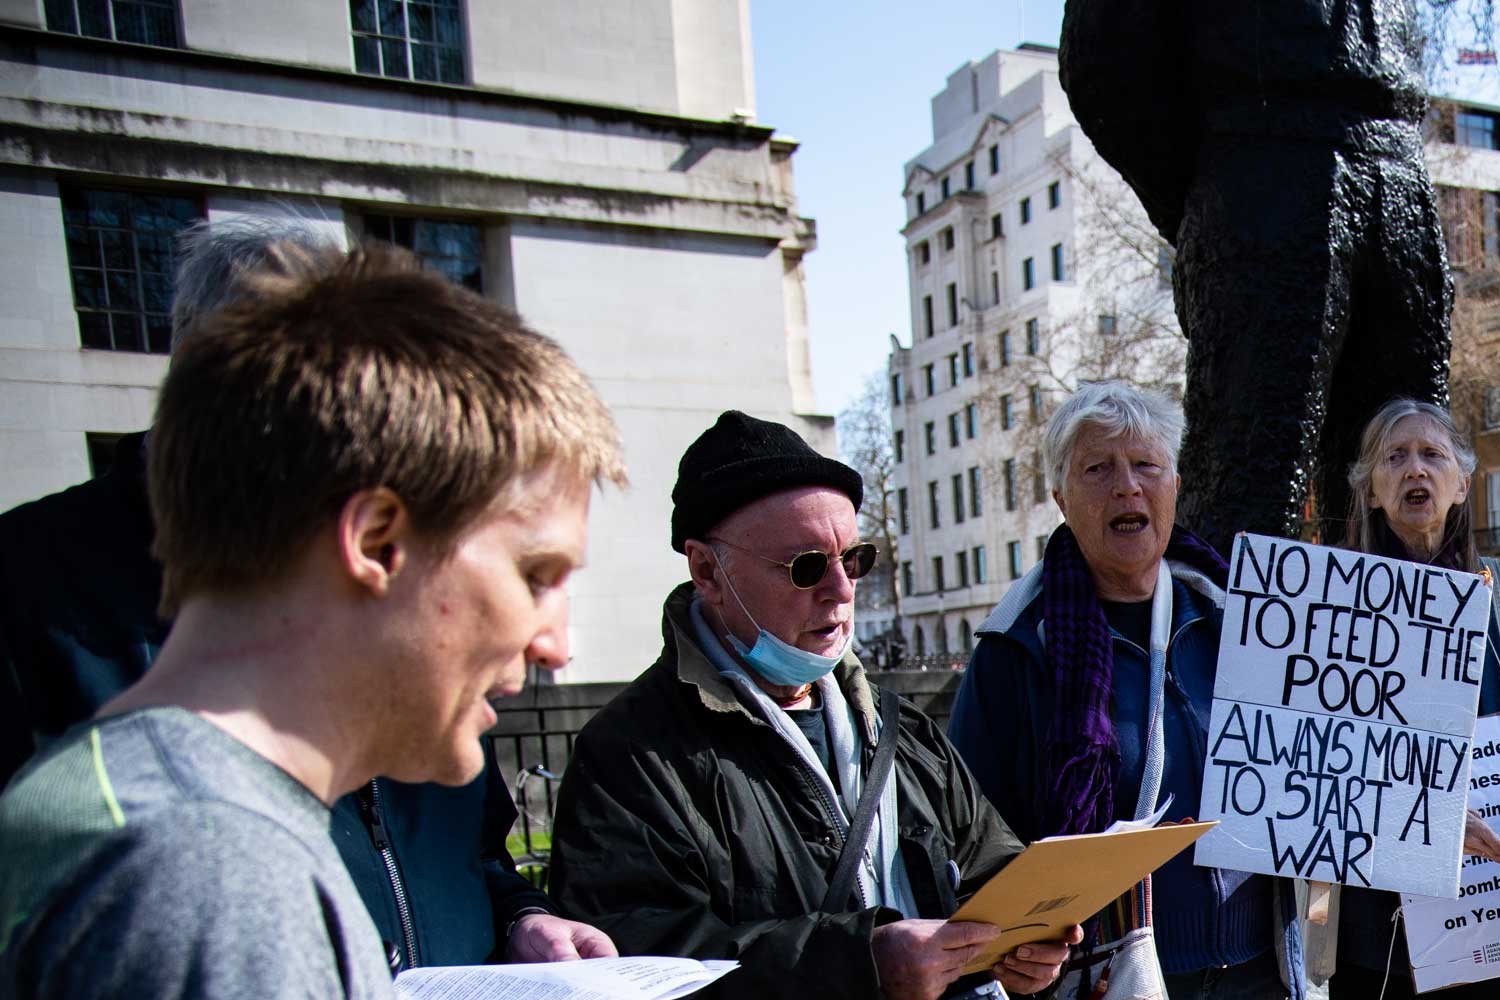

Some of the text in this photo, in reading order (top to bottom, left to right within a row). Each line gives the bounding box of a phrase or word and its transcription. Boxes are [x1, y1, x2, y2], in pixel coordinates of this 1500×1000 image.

[1233, 535, 1479, 628] NO MONEY
[1229, 589, 1484, 685] TO FEED THE
[1282, 654, 1408, 724] POOR
[1211, 703, 1469, 792] ALWAYS MONEY
[1213, 758, 1431, 846] TO START A
[1265, 817, 1373, 887] WAR
[1444, 915, 1467, 930] on
